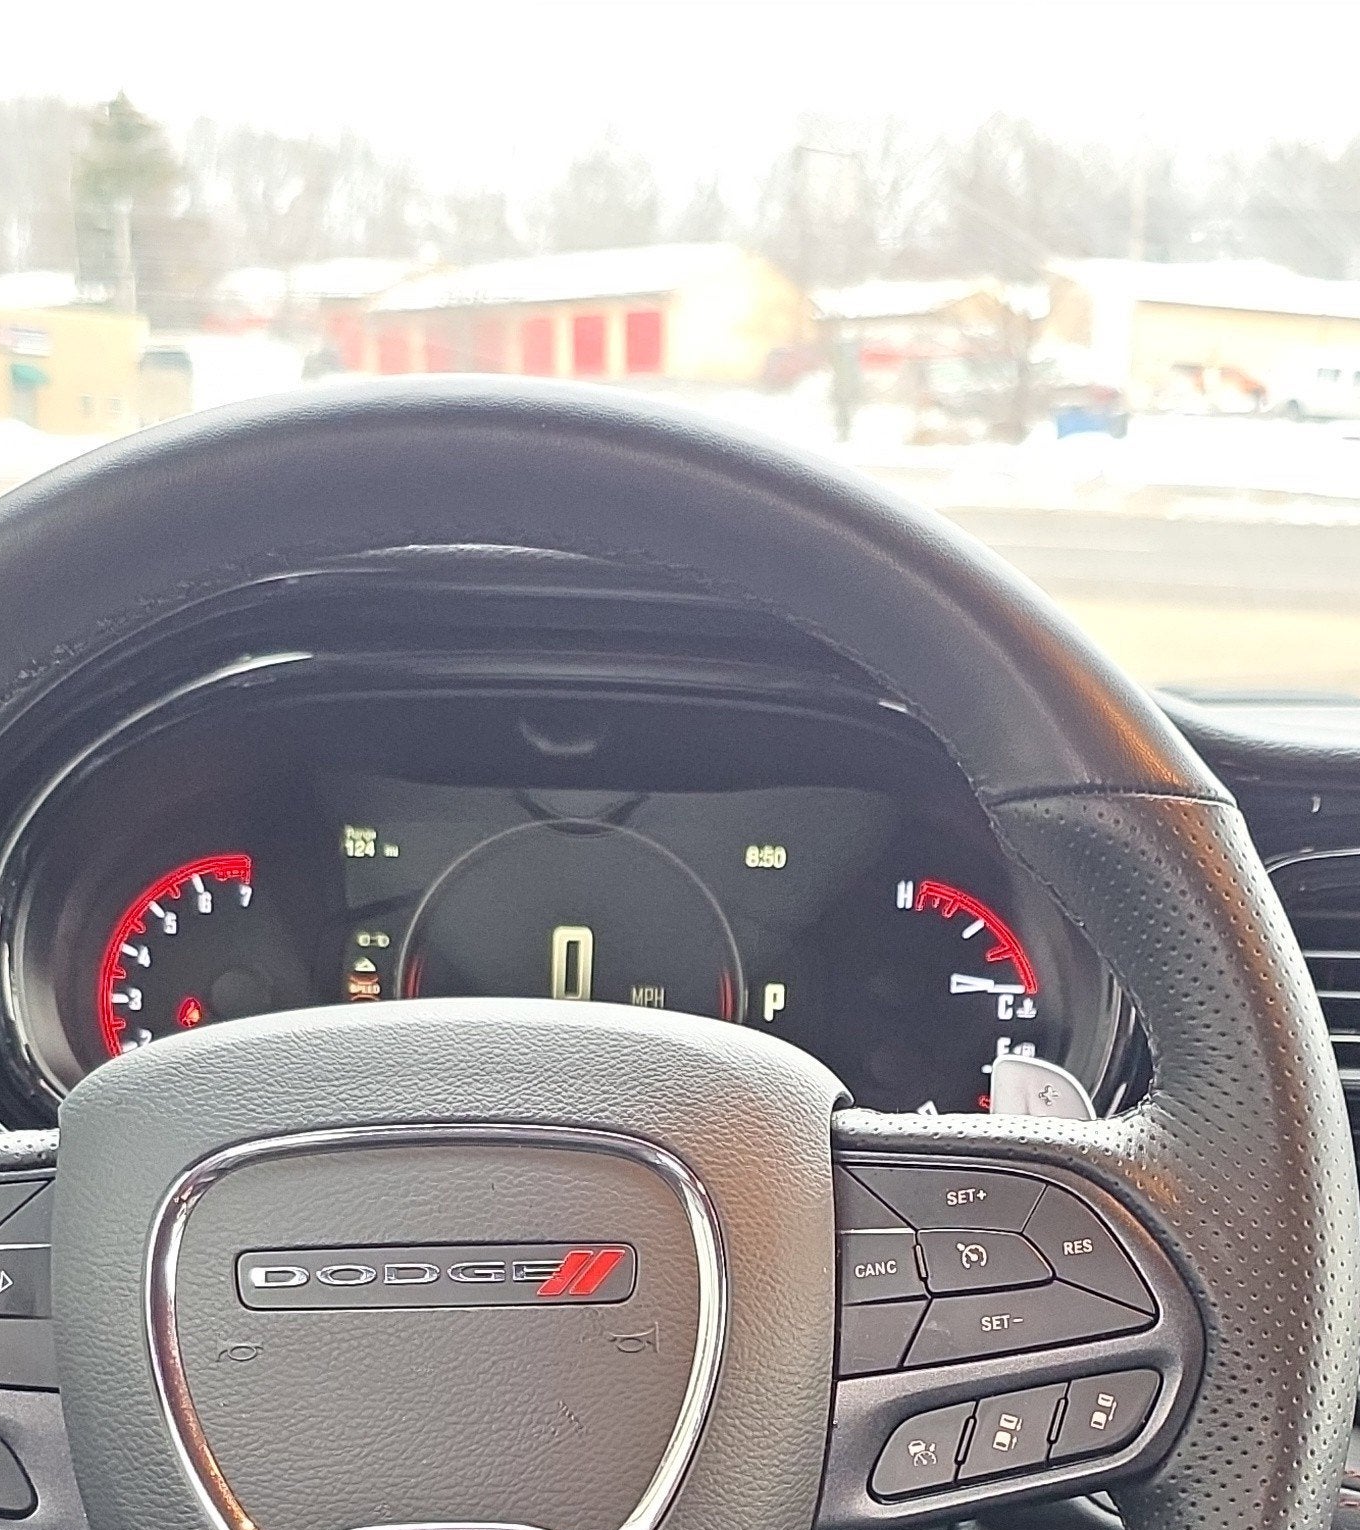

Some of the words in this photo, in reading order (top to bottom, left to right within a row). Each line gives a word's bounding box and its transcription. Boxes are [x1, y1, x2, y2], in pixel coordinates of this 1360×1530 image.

[345, 838, 376, 857] 124
[746, 845, 787, 868] 8:50
[197, 891, 212, 914] 6
[240, 884, 252, 907] 7
[897, 880, 914, 909] H
[163, 911, 178, 934] 5
[138, 945, 151, 968] 4
[128, 988, 142, 1011] 3
[632, 987, 665, 1008] MPH
[764, 983, 786, 1022] P
[998, 995, 1014, 1020] C
[947, 1188, 987, 1205] SET+
[1063, 1239, 1093, 1255] RES
[250, 1261, 566, 1288] DODGE
[855, 1261, 897, 1278] CANC
